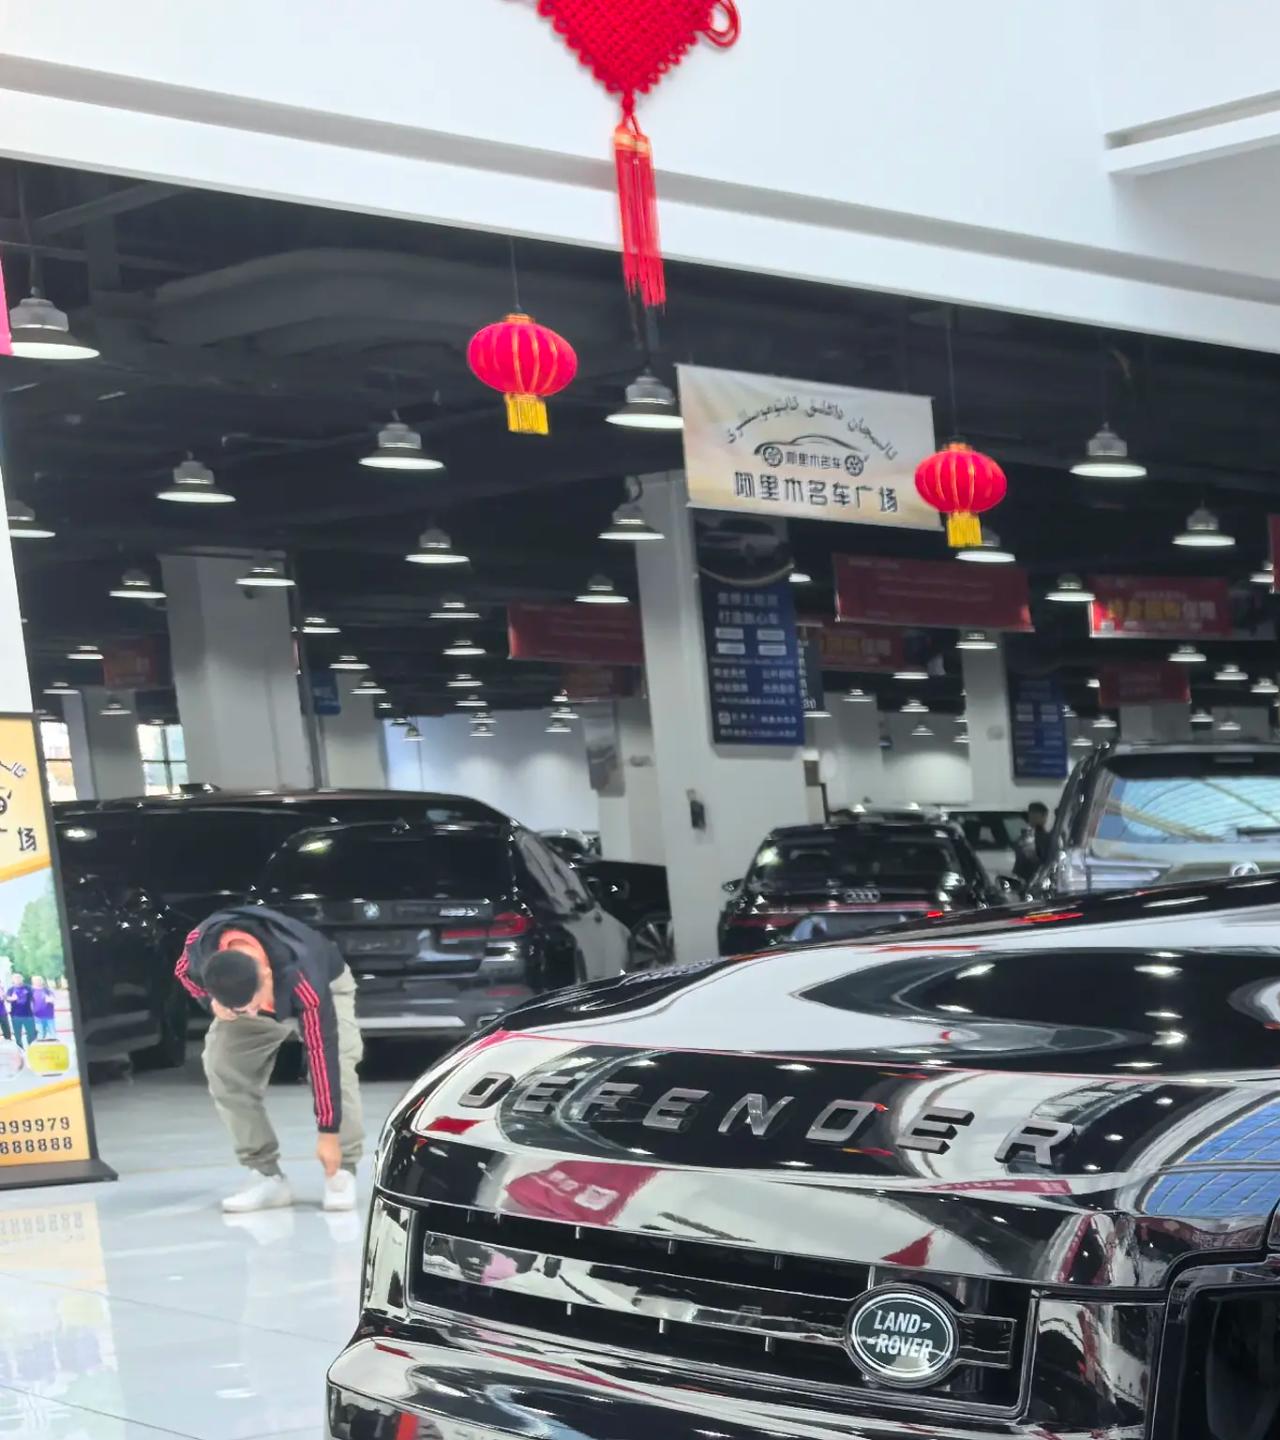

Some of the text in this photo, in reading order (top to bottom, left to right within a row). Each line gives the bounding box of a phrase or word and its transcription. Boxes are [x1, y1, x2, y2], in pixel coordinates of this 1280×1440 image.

[734, 471, 898, 514] 阿里木名车广场
[457, 1072, 1076, 1165] DEFENDER
